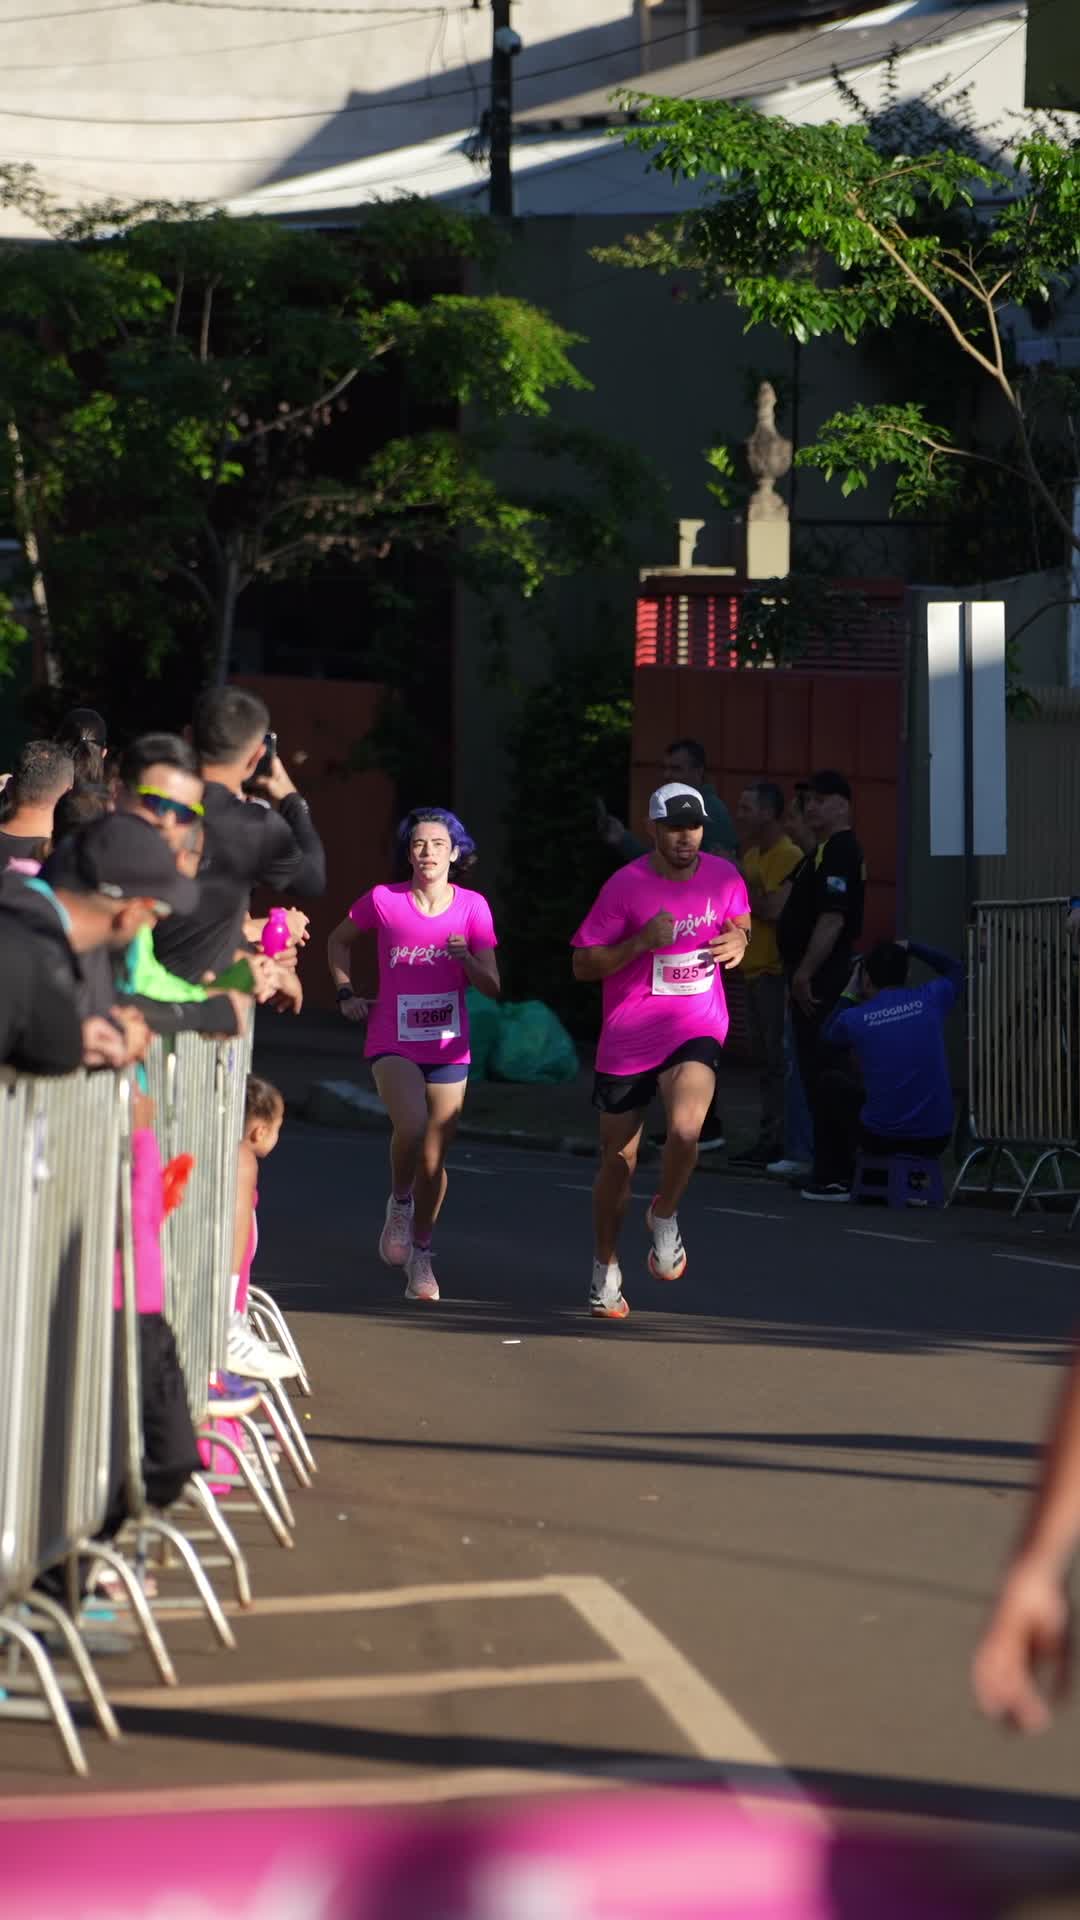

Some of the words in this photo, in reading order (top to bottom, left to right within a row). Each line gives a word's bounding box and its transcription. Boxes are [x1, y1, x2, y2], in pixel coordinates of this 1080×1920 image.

[390, 944, 452, 968] gopin
[672, 967, 699, 980] 825
[414, 1009, 447, 1024] 1260
